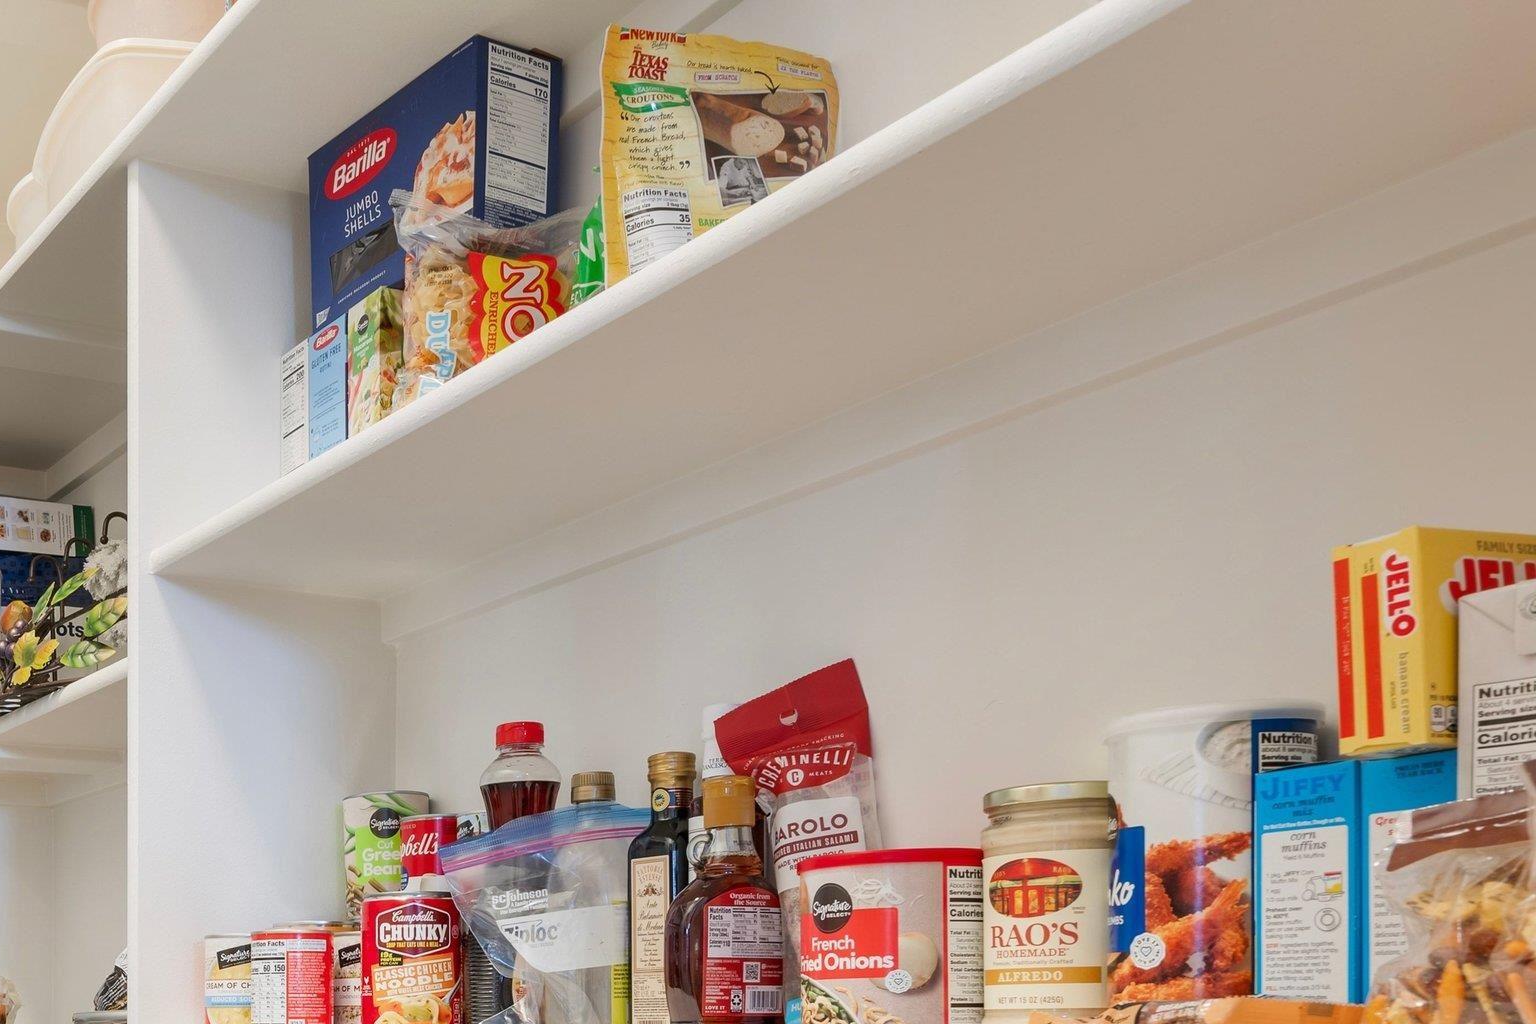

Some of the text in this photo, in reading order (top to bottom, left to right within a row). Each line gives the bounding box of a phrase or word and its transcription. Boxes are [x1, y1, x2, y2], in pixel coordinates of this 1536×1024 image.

[630, 28, 655, 41] New
[491, 44, 549, 71] Nutrition Facts
[631, 50, 669, 70] TEXAS
[628, 66, 667, 81] TOAST
[490, 75, 517, 88] Calories
[534, 87, 549, 99] 170
[626, 93, 675, 105] CROUTONS
[643, 112, 674, 122] croutons
[660, 122, 678, 130] from
[632, 136, 658, 144] French
[629, 145, 651, 153] which
[332, 138, 391, 194] Barilla
[628, 163, 649, 172] crispy
[624, 189, 687, 203] Nutrition Facts
[344, 190, 379, 223] JUMBO
[344, 204, 382, 238] SHELLS
[679, 213, 691, 223] 35
[626, 218, 655, 232] Calories
[312, 352, 329, 369] GLUTEN
[330, 343, 342, 357] FREE
[1477, 540, 1513, 552] FAMILY
[1398, 652, 1409, 698] banana
[1478, 707, 1516, 718] Serving
[1261, 732, 1312, 745] Nutrition
[759, 749, 852, 789] CREMINELLI
[808, 769, 834, 777] MEATS
[1260, 773, 1346, 801] JIFFY
[370, 817, 400, 831] Signature
[1290, 831, 1316, 841] corn
[377, 840, 394, 849] Cut
[792, 834, 855, 853] ITALIAN SALAMI
[1281, 841, 1327, 853] muffins
[362, 848, 400, 862] Gree
[729, 892, 756, 901] Organic
[949, 889, 971, 897] Serving
[813, 900, 852, 920] Signature
[379, 922, 448, 943] CHUNKY
[991, 921, 1079, 948] RAO'S
[811, 935, 855, 951] French
[997, 948, 1066, 959] HOMEMADE
[274, 963, 286, 972] 150
[824, 952, 895, 971] Onions
[374, 961, 452, 982] CLASSIC CHICKEN
[998, 970, 1063, 983] ALFREDO
[375, 972, 454, 992] NOODLE
[998, 996, 1008, 1004] NET
